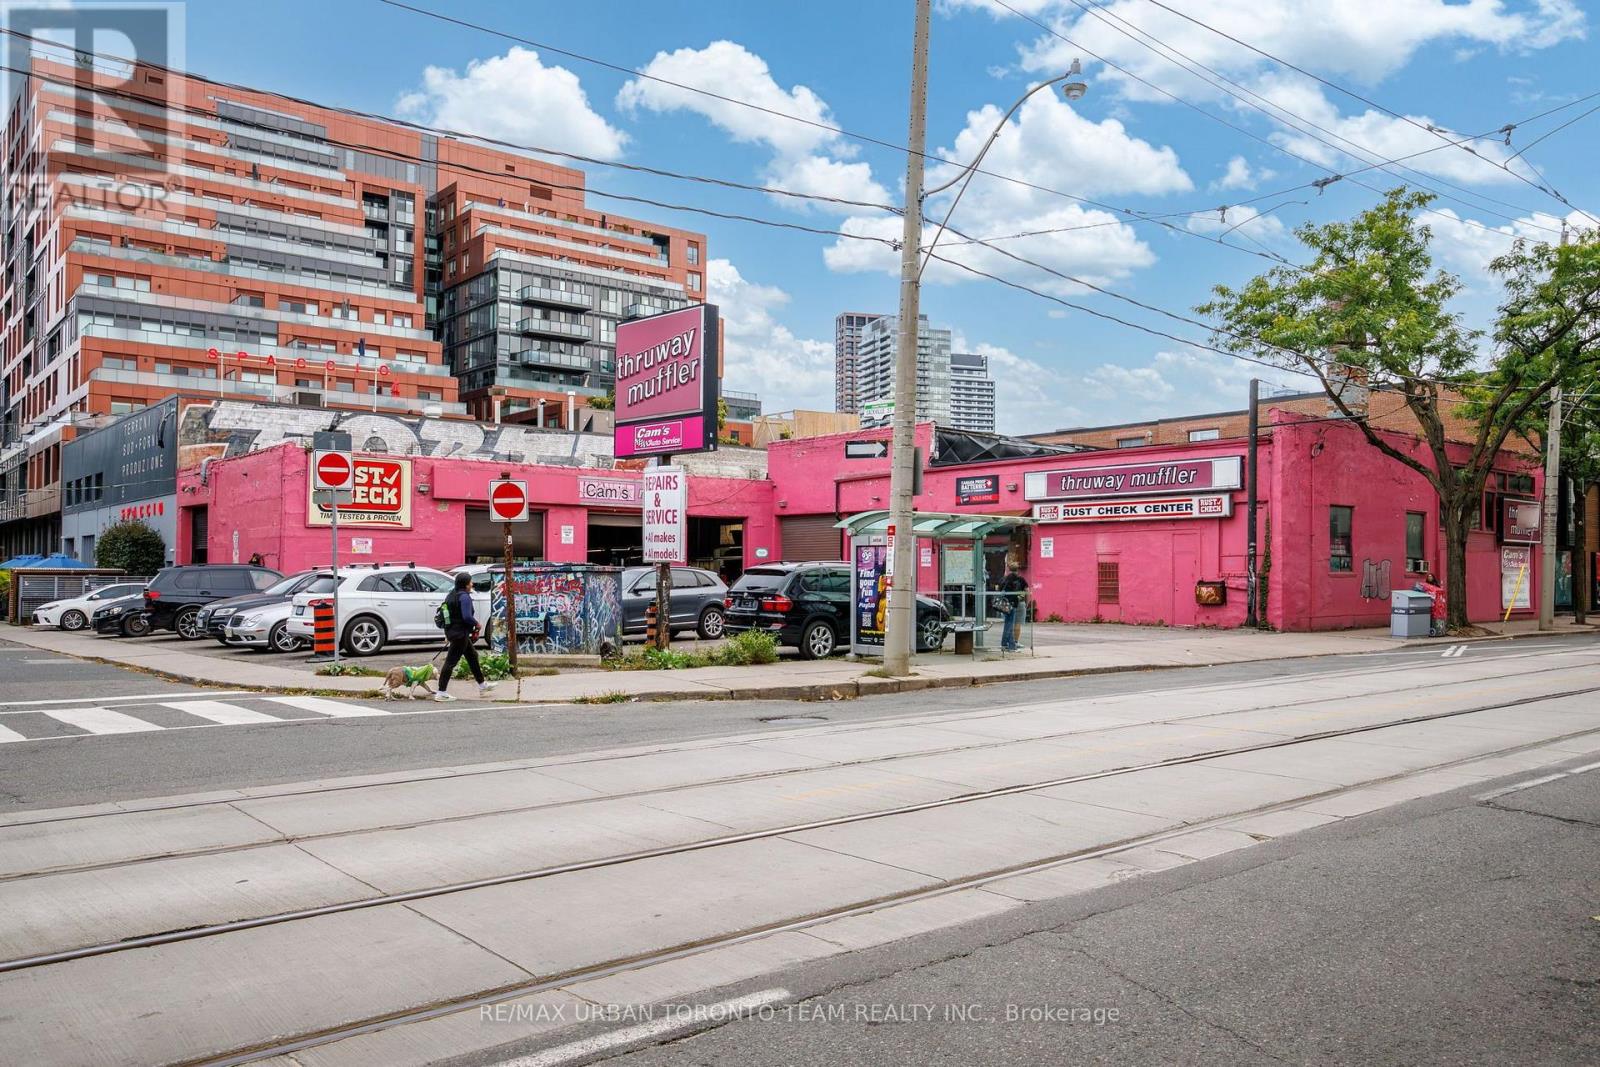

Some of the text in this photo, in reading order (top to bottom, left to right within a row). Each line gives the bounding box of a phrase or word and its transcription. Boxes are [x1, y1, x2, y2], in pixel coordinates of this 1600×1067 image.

[617, 328, 696, 380] thruway
[207, 348, 390, 376] SPACCIO
[627, 358, 699, 407] muffler
[637, 426, 670, 438] Cam's
[355, 466, 384, 485] ST
[1061, 466, 1197, 491] thruway muffler
[354, 486, 398, 505] ECK
[586, 484, 629, 499] Cam's
[654, 493, 661, 507] &
[1200, 498, 1217, 506] RUST
[1063, 503, 1193, 517] RUST CHECK CENTER
[1200, 505, 1221, 513] CHECK
[646, 509, 678, 525] SERVICE
[653, 532, 676, 543] makes
[653, 548, 678, 559] models
[860, 569, 875, 578] Find
[860, 579, 875, 589] your
[861, 587, 873, 598] fun
